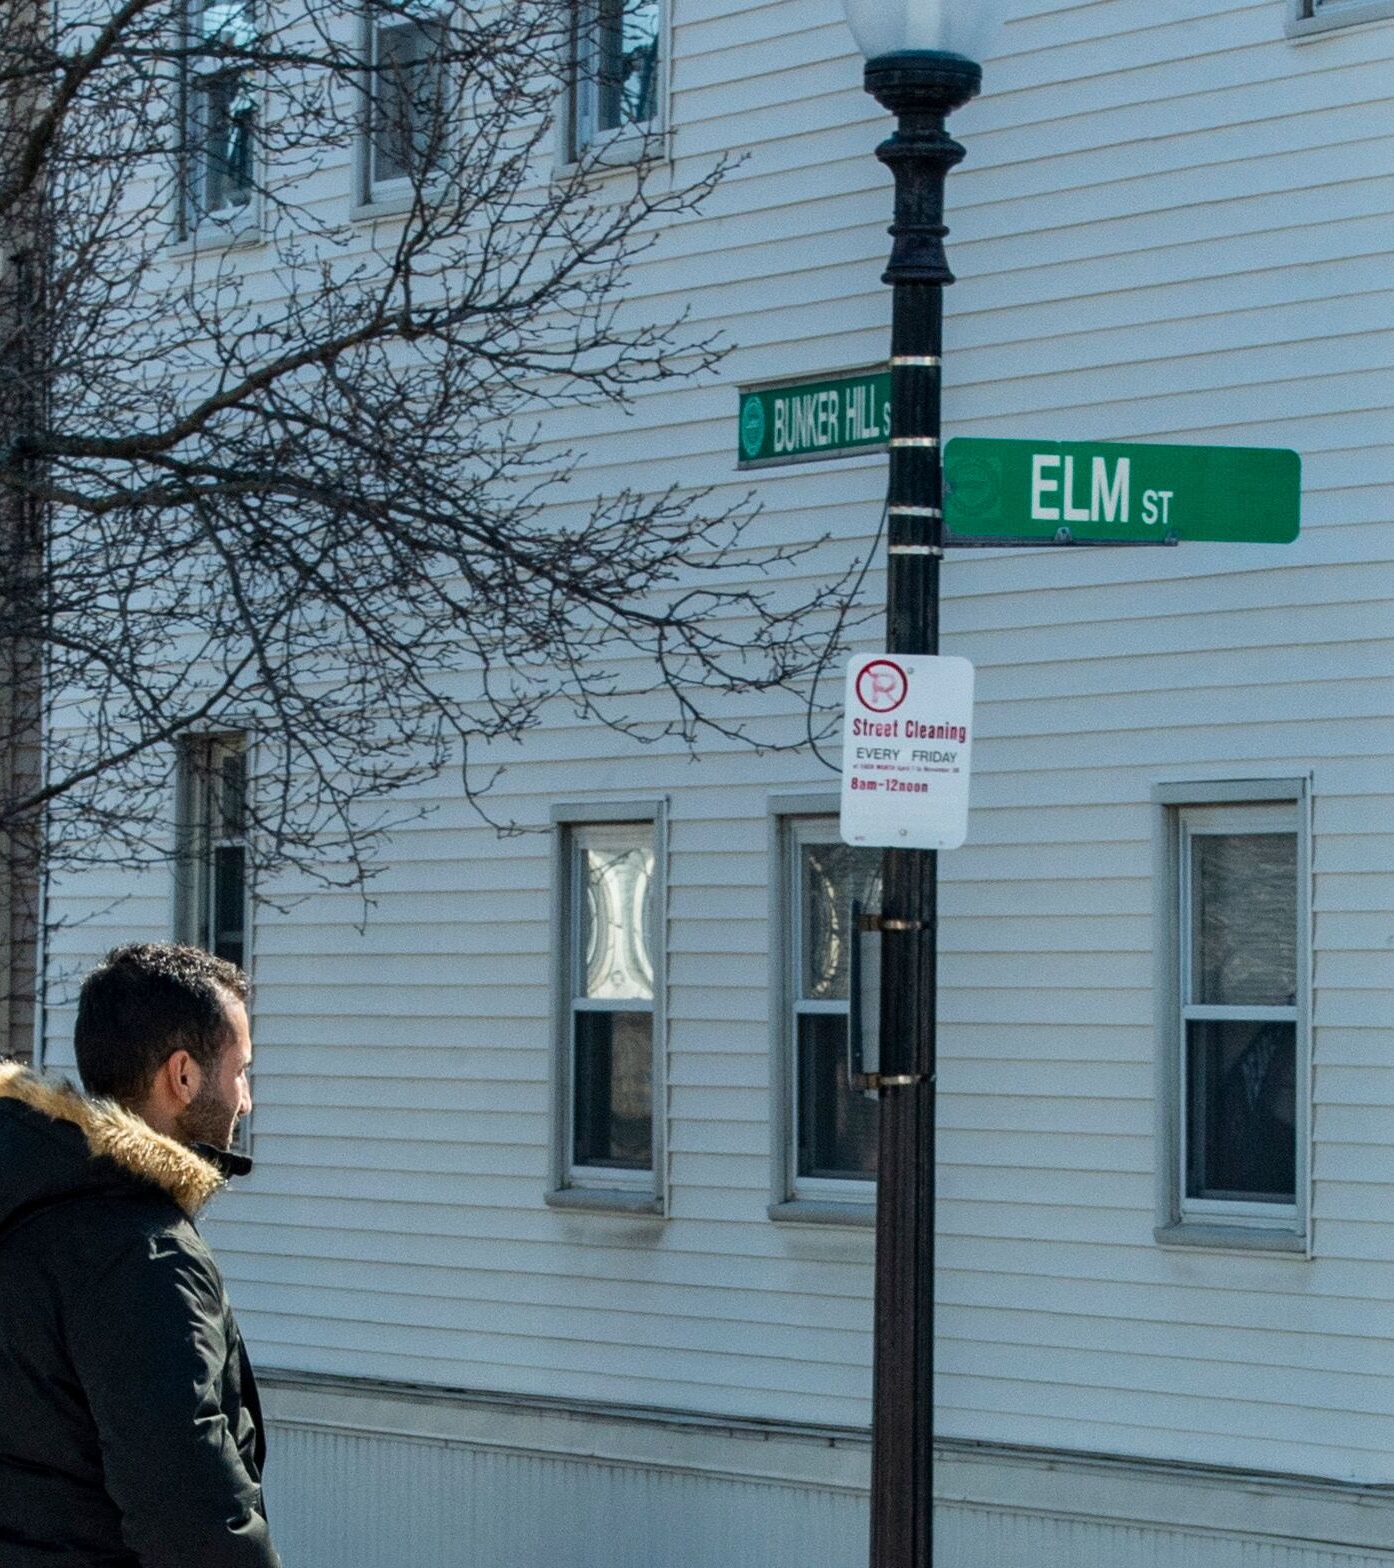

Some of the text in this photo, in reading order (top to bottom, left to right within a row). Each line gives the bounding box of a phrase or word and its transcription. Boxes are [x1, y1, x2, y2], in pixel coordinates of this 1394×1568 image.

[773, 383, 891, 452] BUNKER HILL S
[1030, 454, 1174, 525] ELM ST
[852, 718, 967, 743] Street Cleaning
[856, 747, 957, 763] EVERY FRIDAY
[851, 777, 929, 793] 8am-12noon
